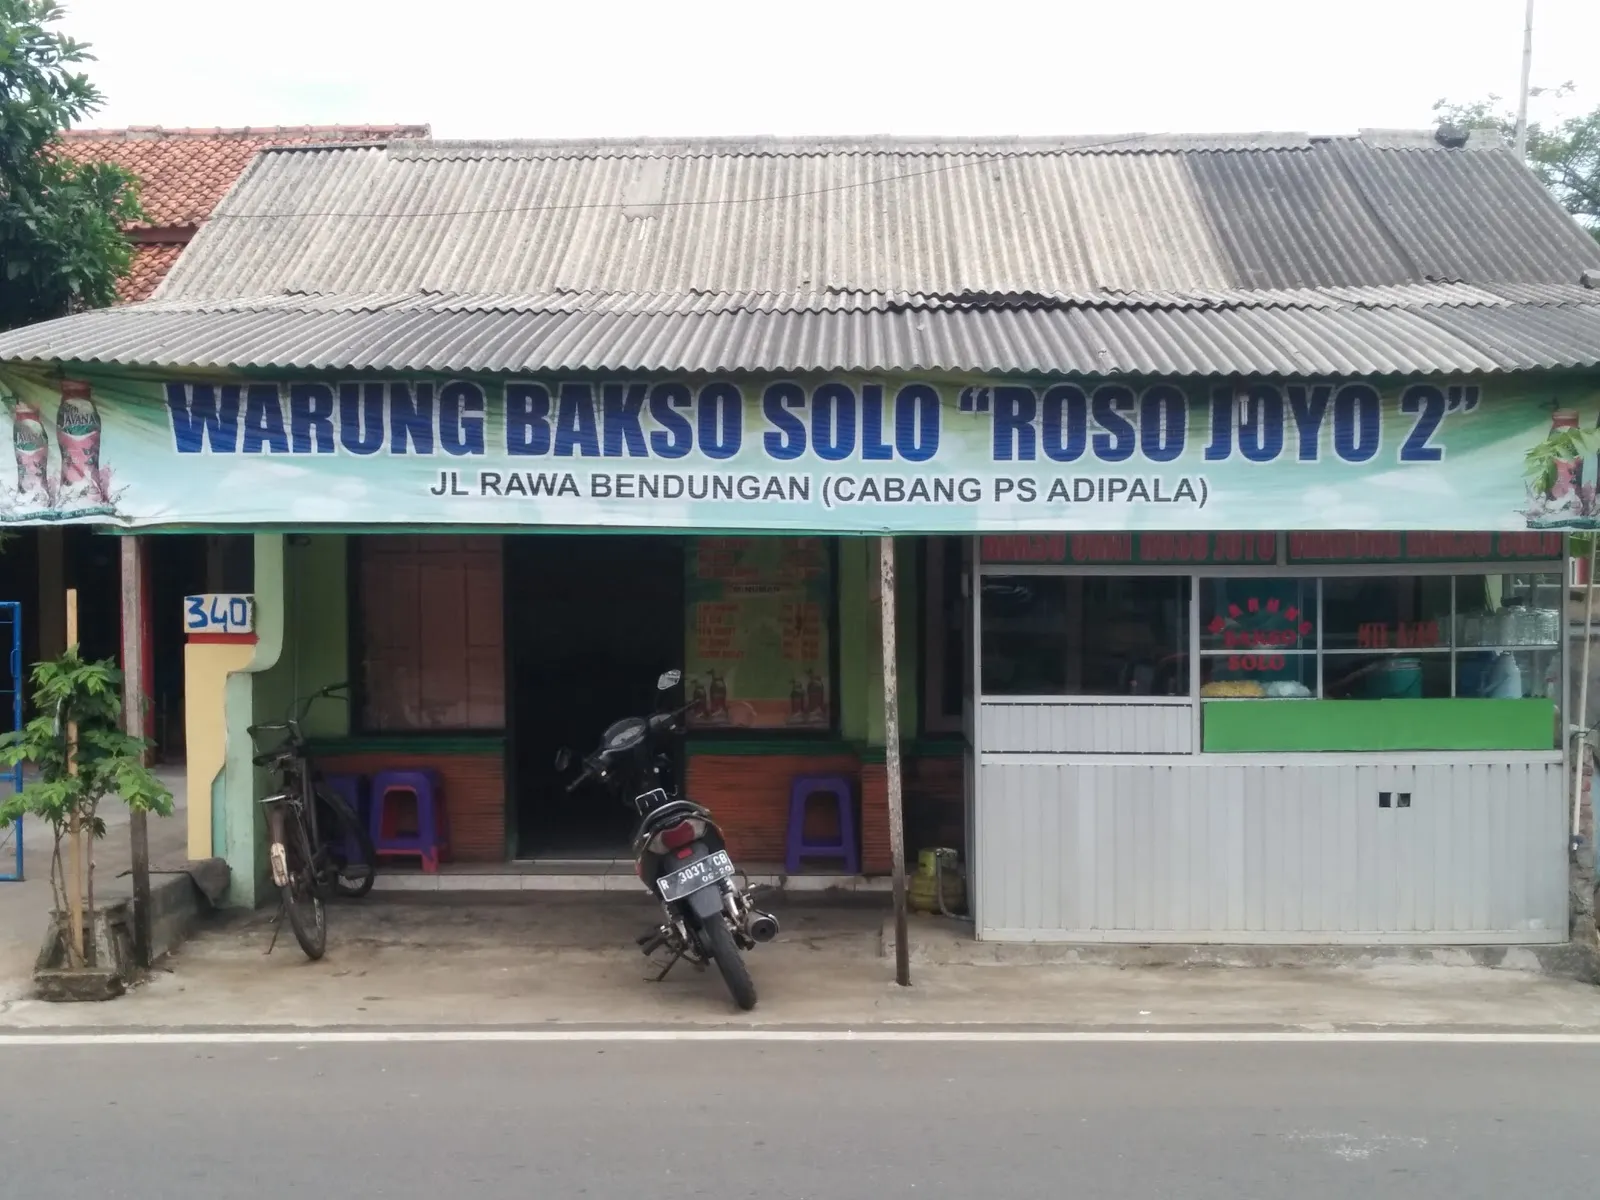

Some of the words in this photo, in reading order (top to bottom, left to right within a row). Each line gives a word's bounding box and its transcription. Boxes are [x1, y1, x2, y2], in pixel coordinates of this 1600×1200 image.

[165, 380, 486, 457] WARUNG
[505, 380, 742, 459] BAKSO
[764, 382, 940, 462] SOLO
[1204, 384, 1382, 462] JOYO
[431, 470, 467, 496] JL
[480, 471, 580, 498] RAWA
[591, 474, 809, 501] BENDUNGAN
[823, 475, 981, 508] (CABANG
[995, 477, 1037, 502] PS
[1047, 477, 1209, 507] ADIPALA)
[185, 596, 248, 632] 340
[1227, 654, 1286, 671] SOLO
[660, 879, 670, 891] R
[678, 862, 706, 883] 3037
[712, 853, 728, 866] CB
